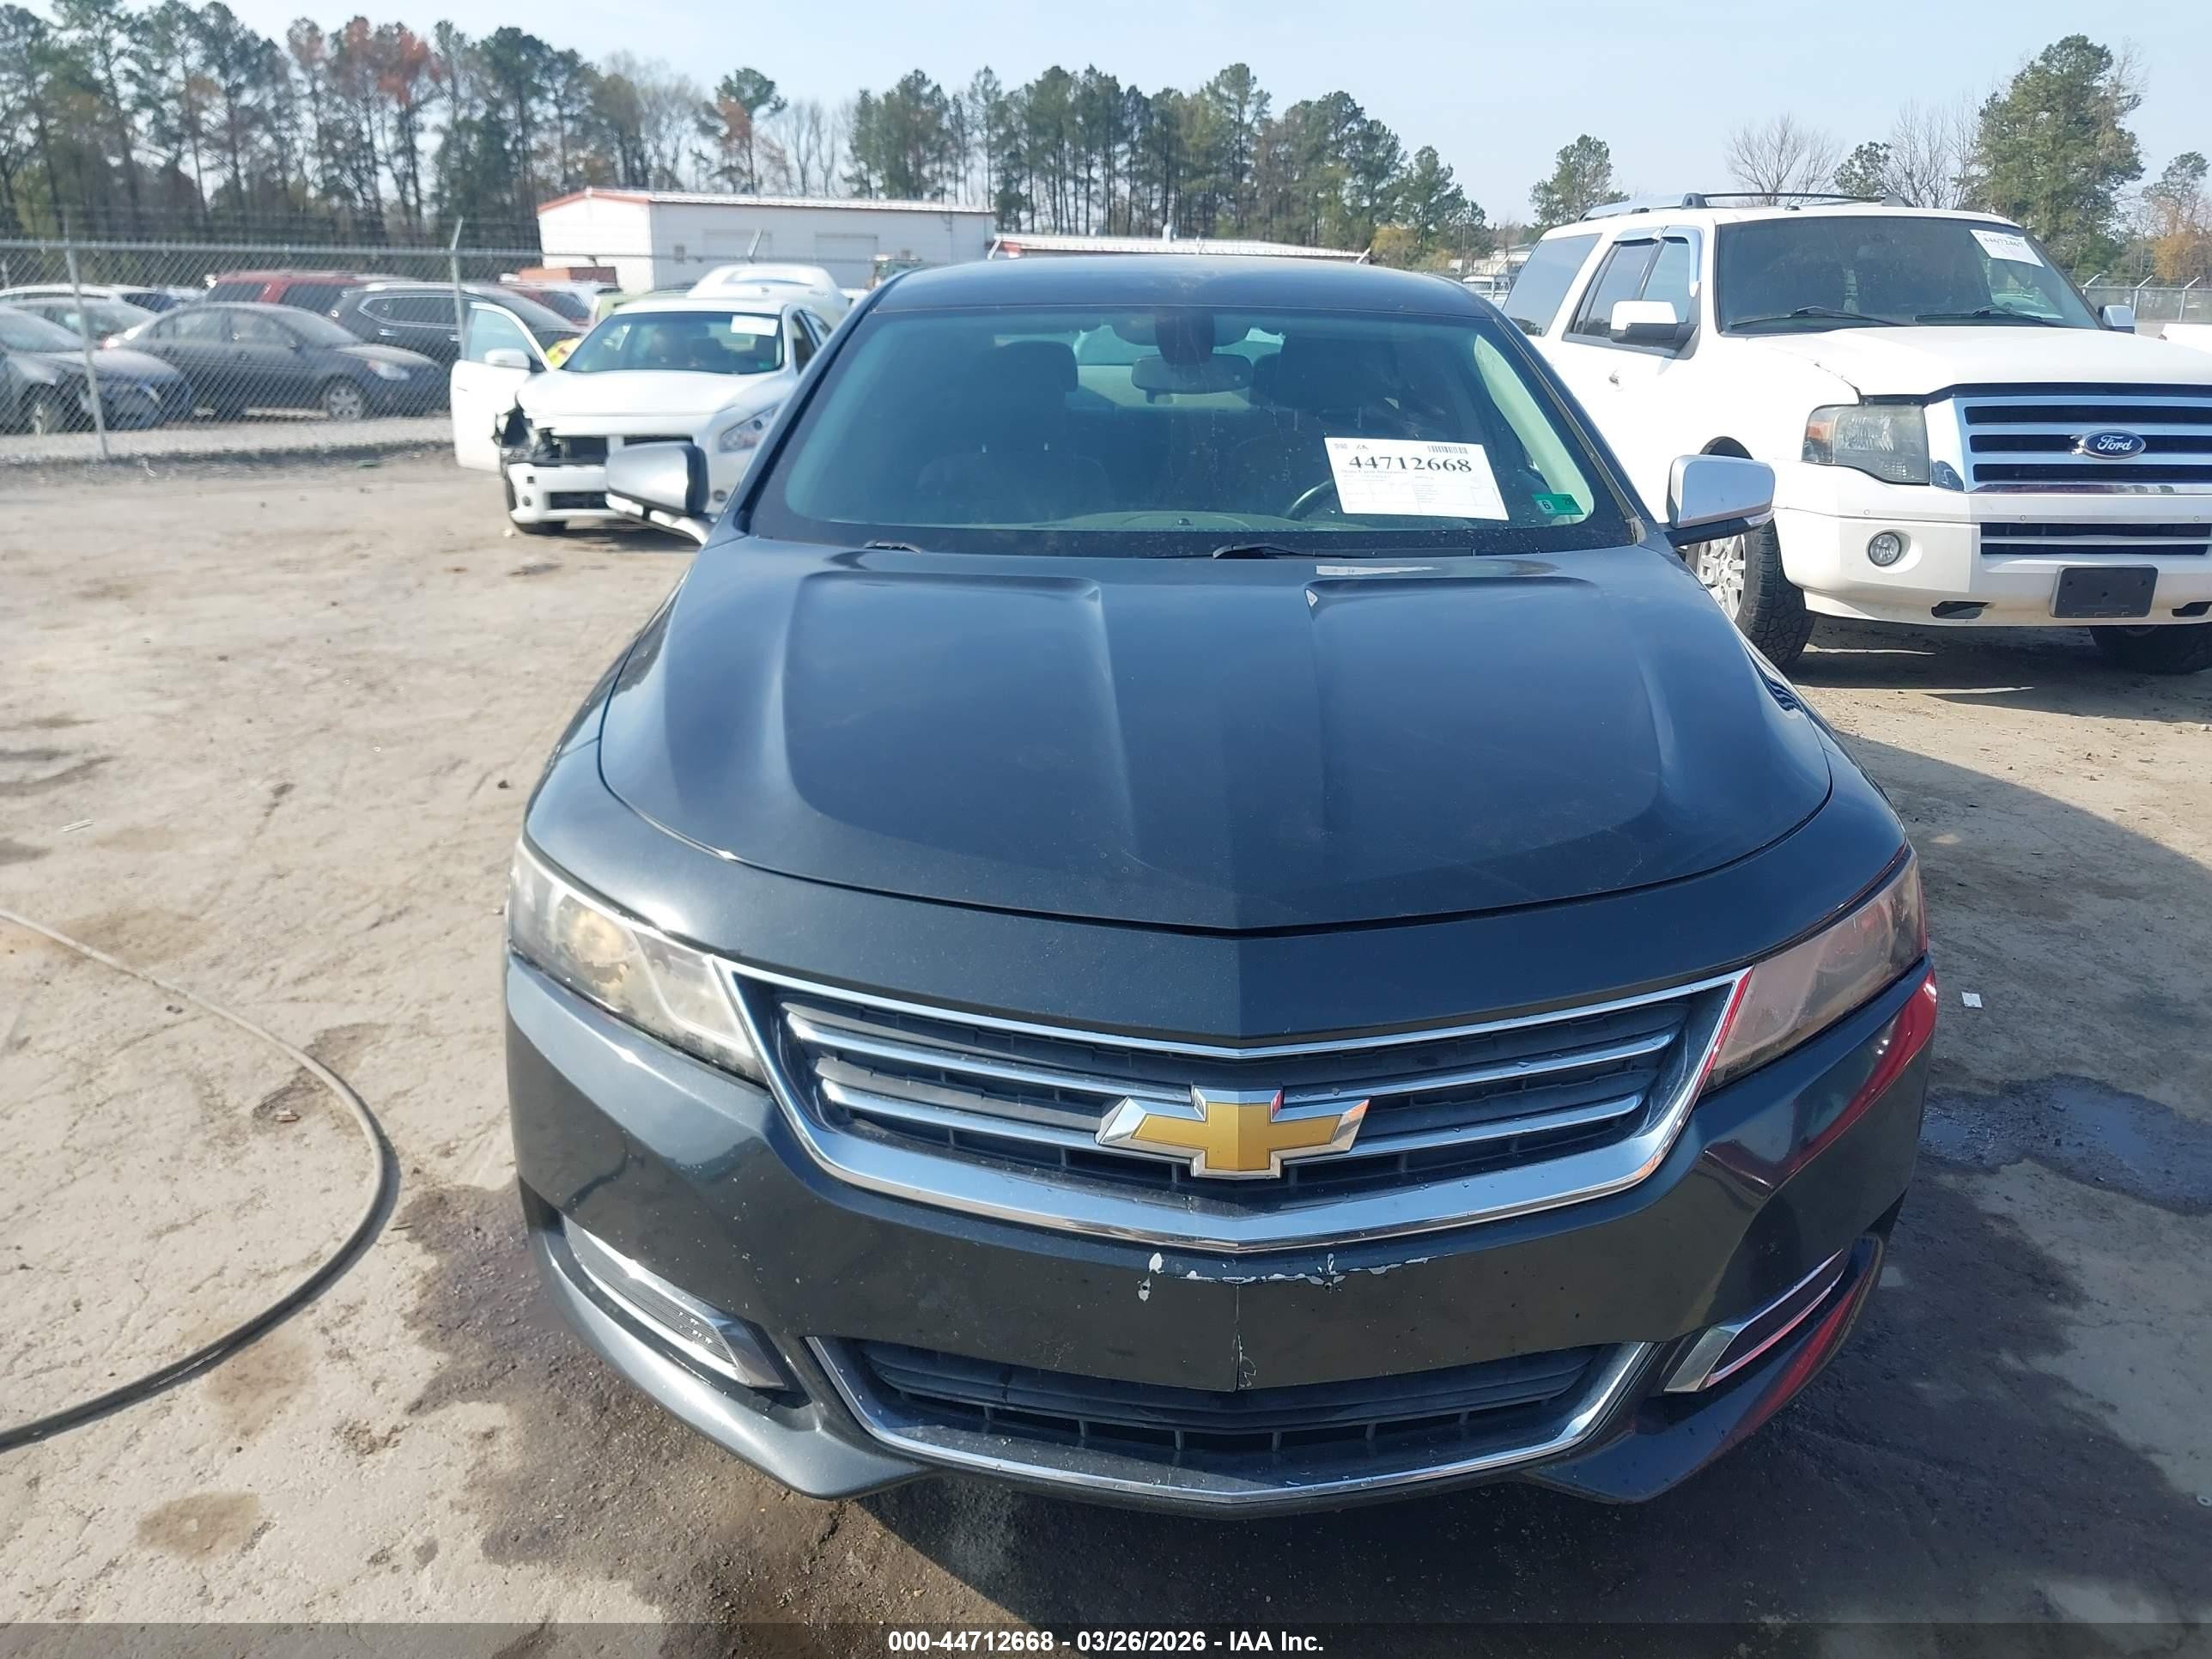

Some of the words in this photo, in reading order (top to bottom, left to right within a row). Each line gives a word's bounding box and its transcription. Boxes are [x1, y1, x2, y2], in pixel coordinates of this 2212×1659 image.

[2097, 434, 2133, 451] Ford
[1349, 455, 1472, 473] 44712668
[1541, 501, 1551, 510] 6
